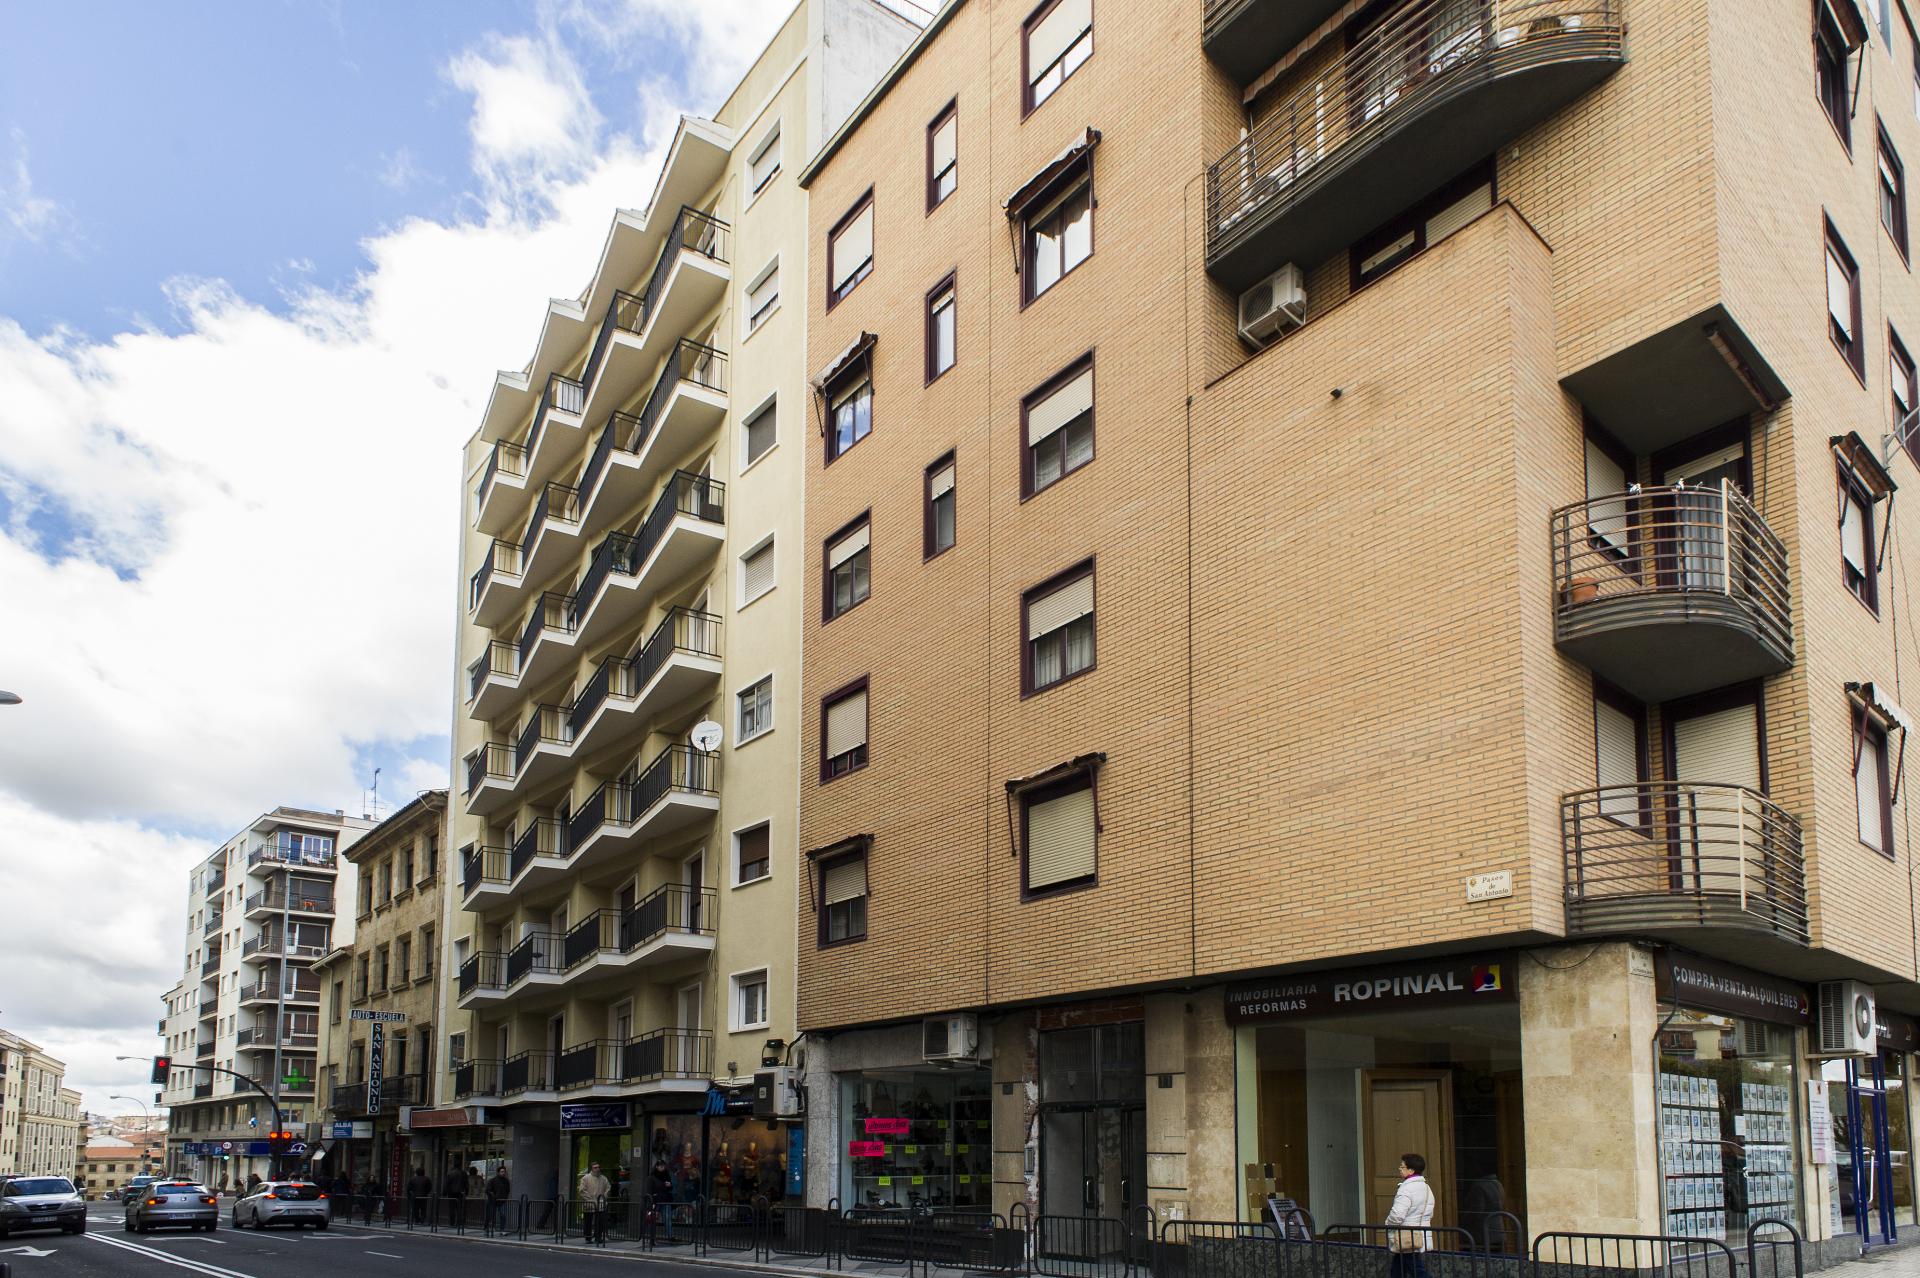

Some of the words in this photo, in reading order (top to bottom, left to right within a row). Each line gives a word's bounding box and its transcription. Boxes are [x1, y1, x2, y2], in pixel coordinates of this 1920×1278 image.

[1482, 875, 1503, 883] Paseo
[1485, 888, 1509, 896] Antonio
[1229, 984, 1317, 1003] INMOBILIARIA
[1334, 970, 1464, 1002] ROPINAL
[1240, 999, 1308, 1016] REFORMAS
[373, 1024, 382, 1049] SAN
[369, 1054, 382, 1114] ANTONIO
